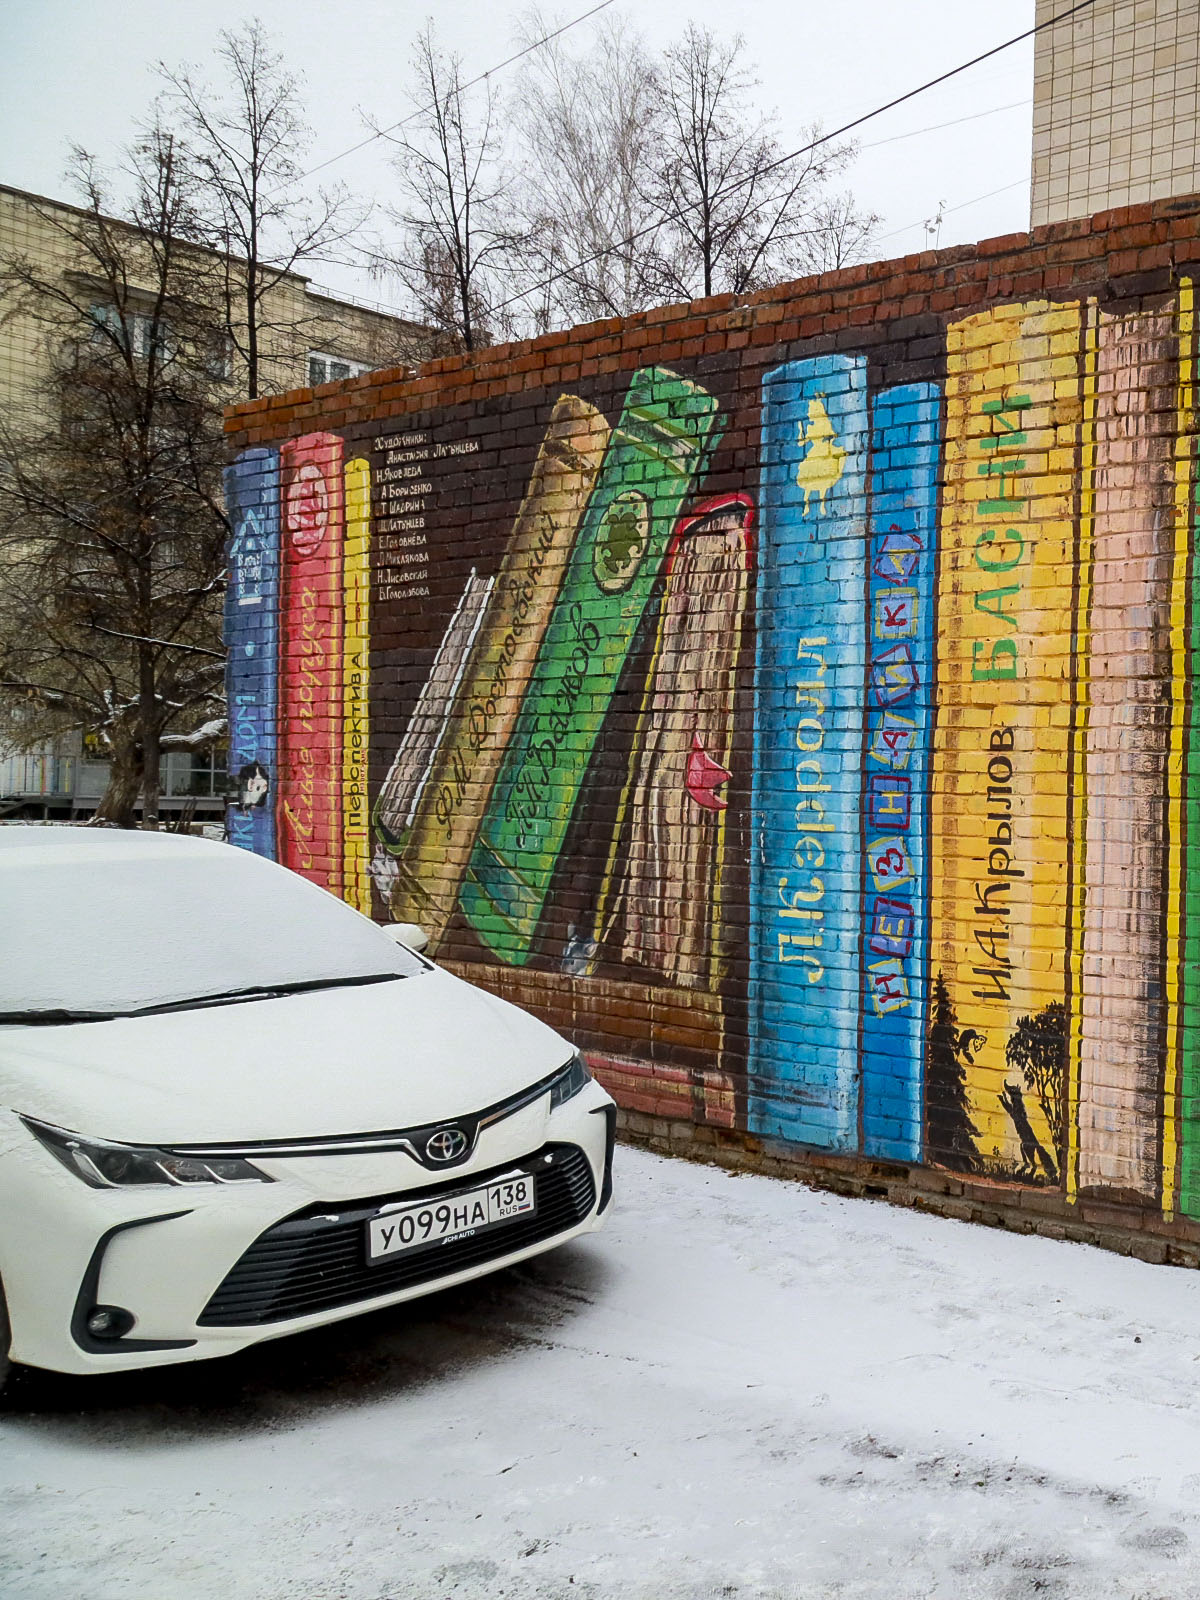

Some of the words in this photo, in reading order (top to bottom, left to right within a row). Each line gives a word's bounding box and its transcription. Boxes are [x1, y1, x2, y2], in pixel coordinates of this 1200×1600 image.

[972, 394, 1032, 682] БАСНИ
[490, 1182, 527, 1209] 138
[499, 1204, 518, 1217] RUS
